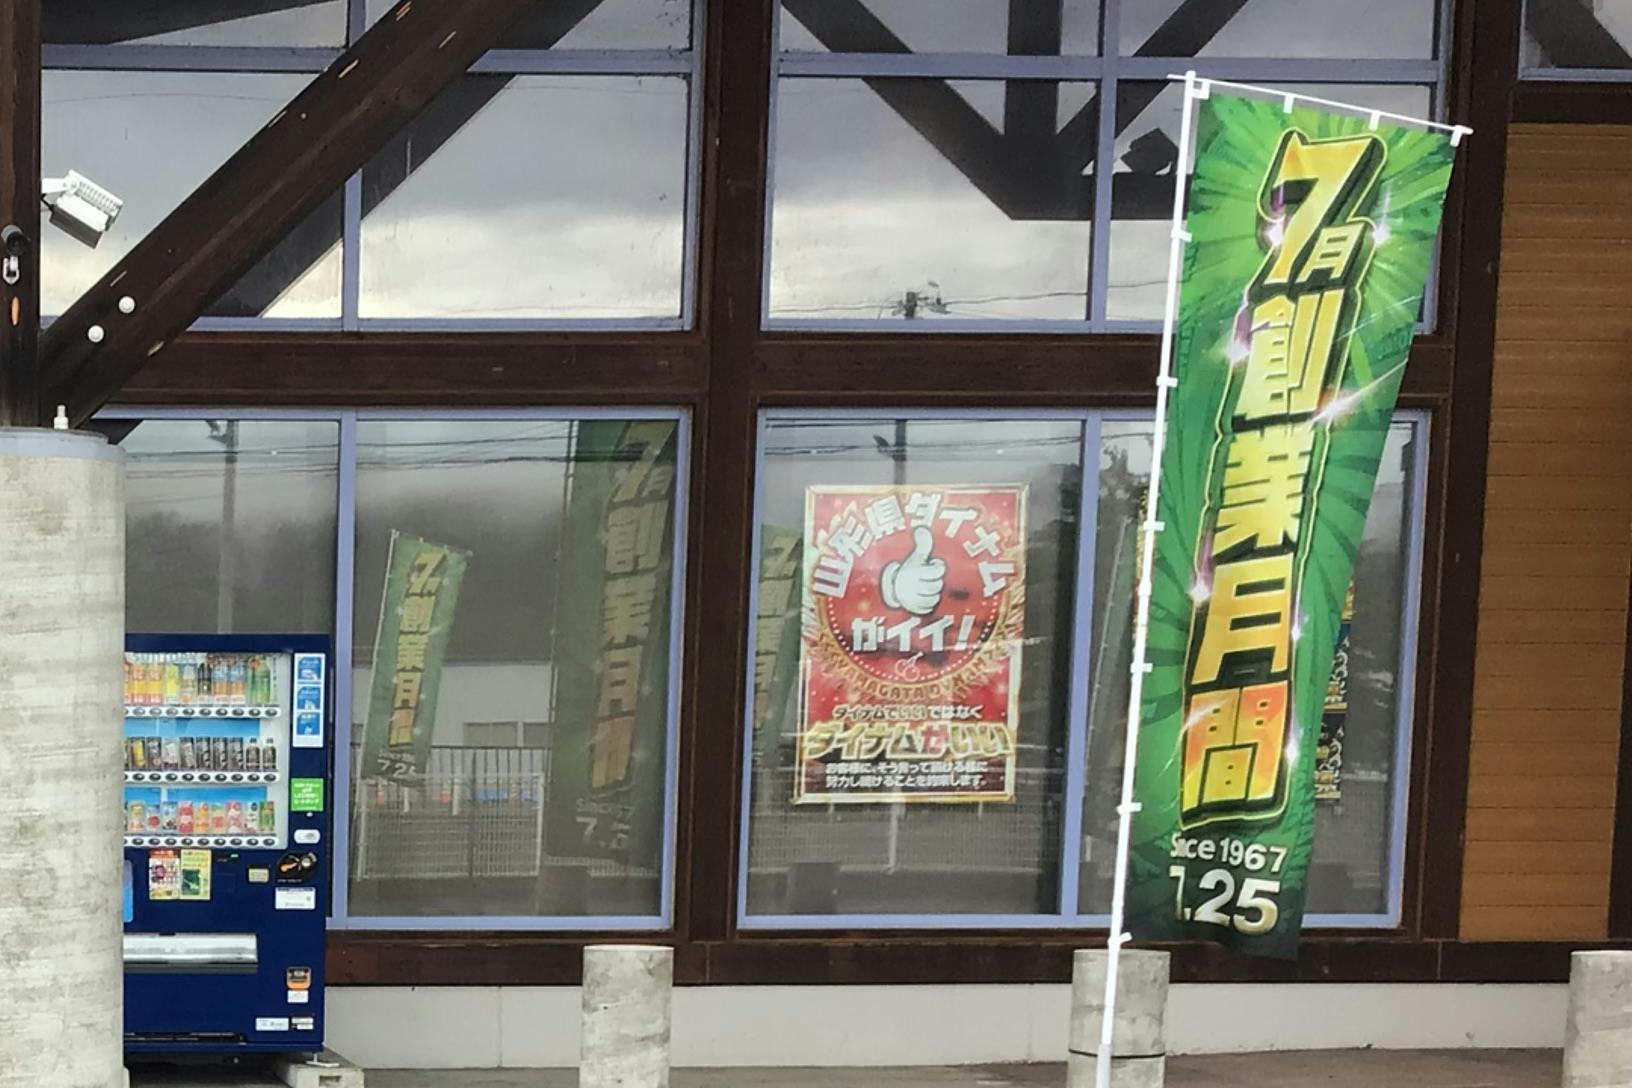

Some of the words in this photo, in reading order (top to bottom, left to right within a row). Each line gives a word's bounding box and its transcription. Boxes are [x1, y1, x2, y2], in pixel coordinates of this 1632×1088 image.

[813, 492, 1015, 598] 山形県ダイナム
[1170, 832, 1216, 861] Sce
[1219, 837, 1288, 873] 1967
